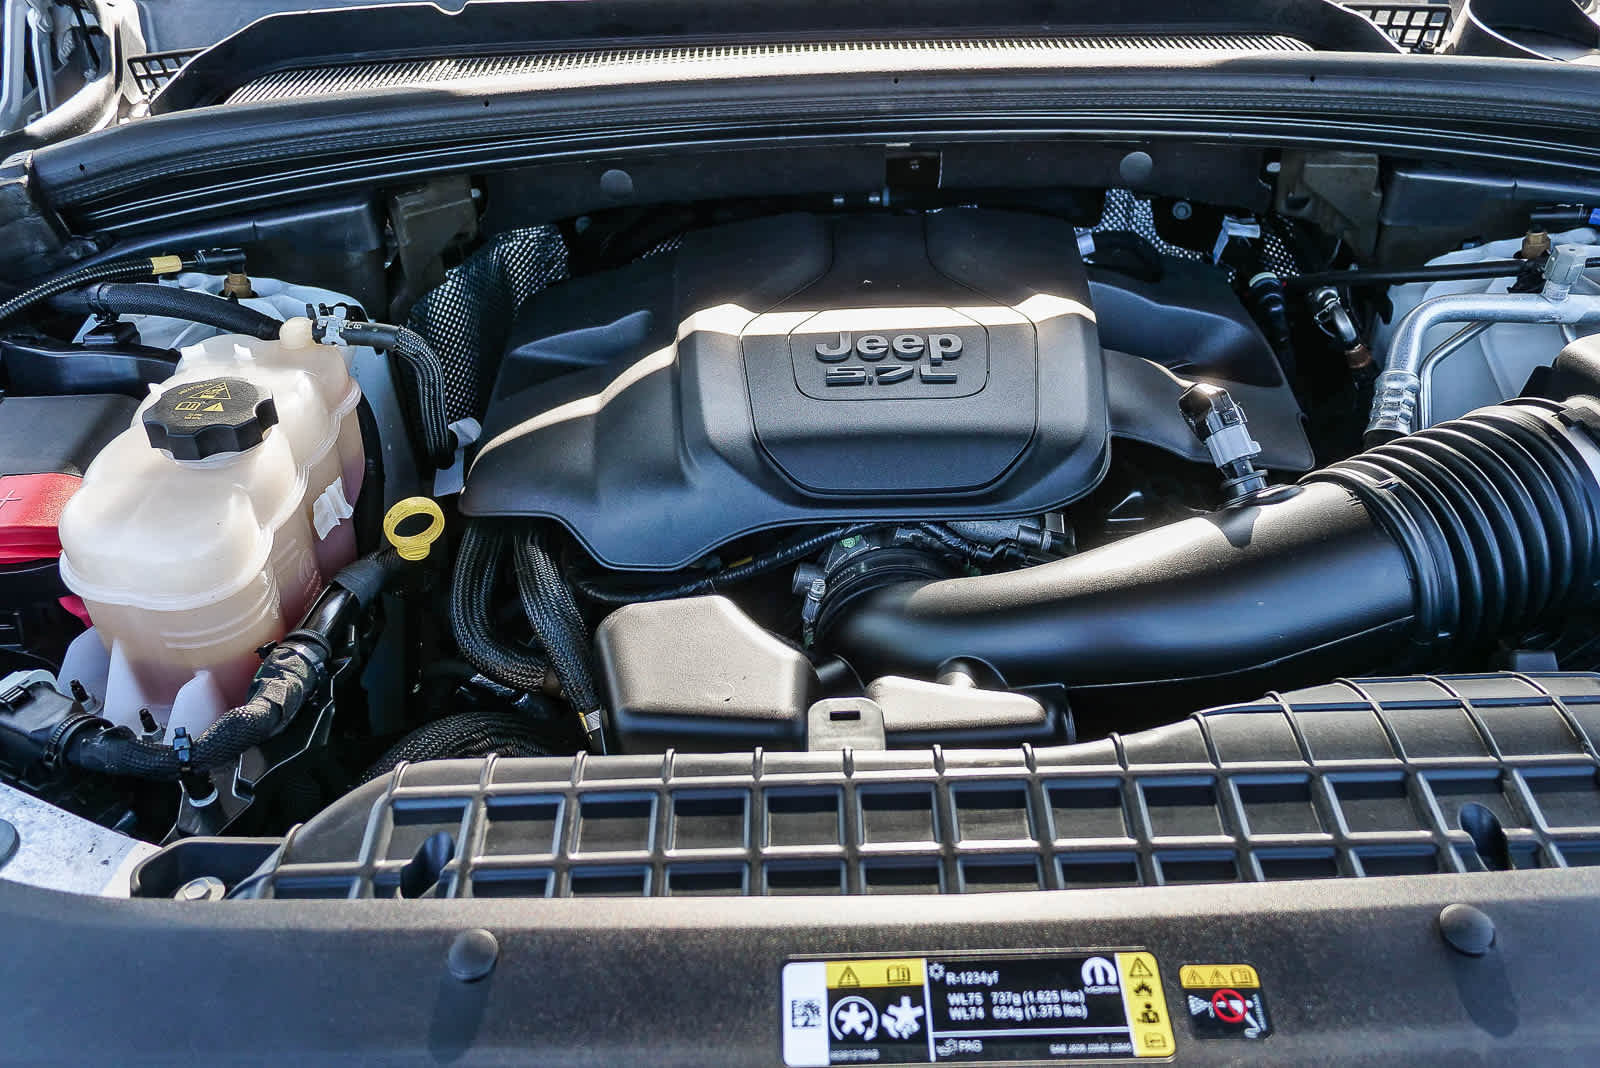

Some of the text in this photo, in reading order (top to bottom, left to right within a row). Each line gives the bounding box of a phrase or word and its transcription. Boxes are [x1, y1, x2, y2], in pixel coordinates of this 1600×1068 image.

[815, 331, 963, 366] Jeep
[826, 364, 958, 386] 5.7L
[945, 971, 999, 986] R-1234yf
[947, 992, 984, 1006] WL75
[990, 991, 1022, 1006] 737g
[949, 1006, 985, 1020] WL74
[957, 1039, 983, 1053] PAG
